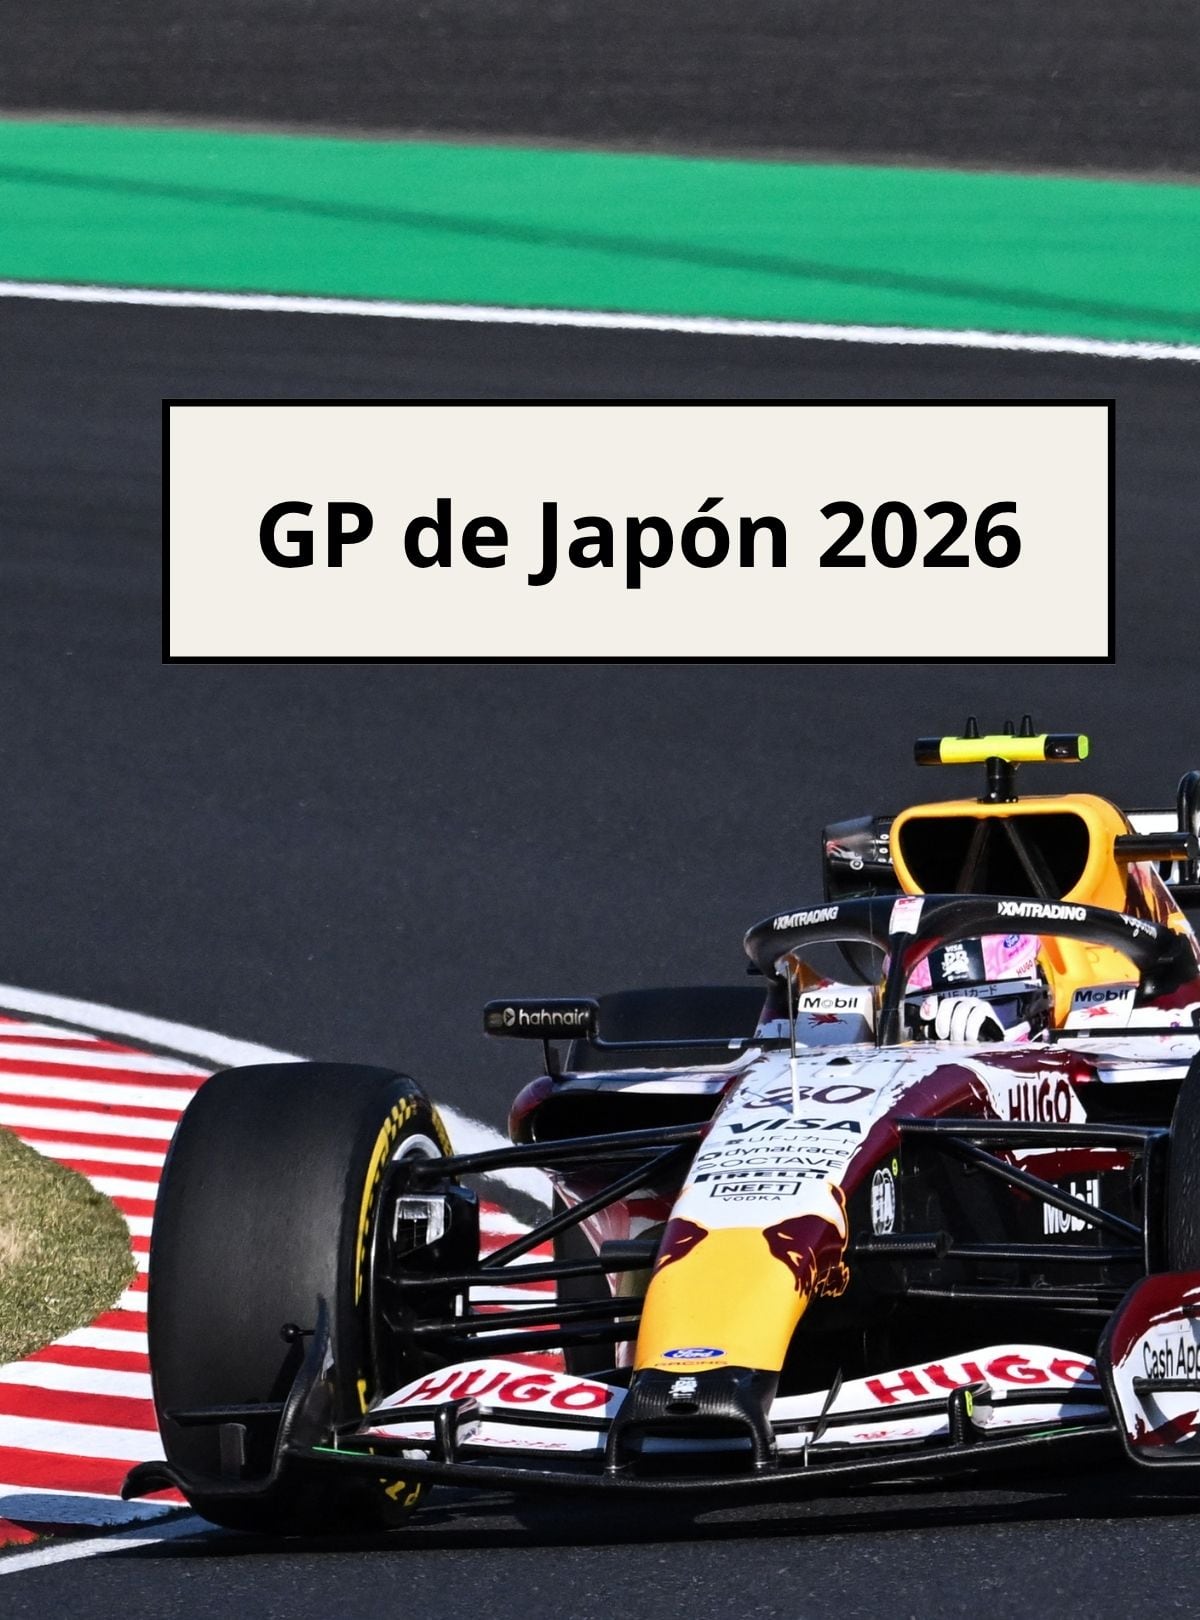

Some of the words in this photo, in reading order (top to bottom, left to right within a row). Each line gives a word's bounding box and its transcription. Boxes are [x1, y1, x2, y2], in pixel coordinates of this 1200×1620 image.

[1000, 902, 1087, 921] XMTRADING
[1016, 960, 1034, 976] HUGO
[803, 997, 859, 1009] Mobil
[1075, 988, 1130, 1003] Mobil
[519, 1008, 586, 1025] hahnair
[742, 1085, 876, 1109] 30
[1008, 1078, 1072, 1123] HUGO
[722, 1118, 862, 1134] VISA
[724, 1145, 850, 1158] dynatrace
[693, 1168, 829, 1184] PIRELLI
[721, 1183, 785, 1194] NEFT
[1143, 1339, 1174, 1379] Cash
[866, 1355, 1101, 1404] HUGO
[393, 1369, 615, 1410] HUGO
